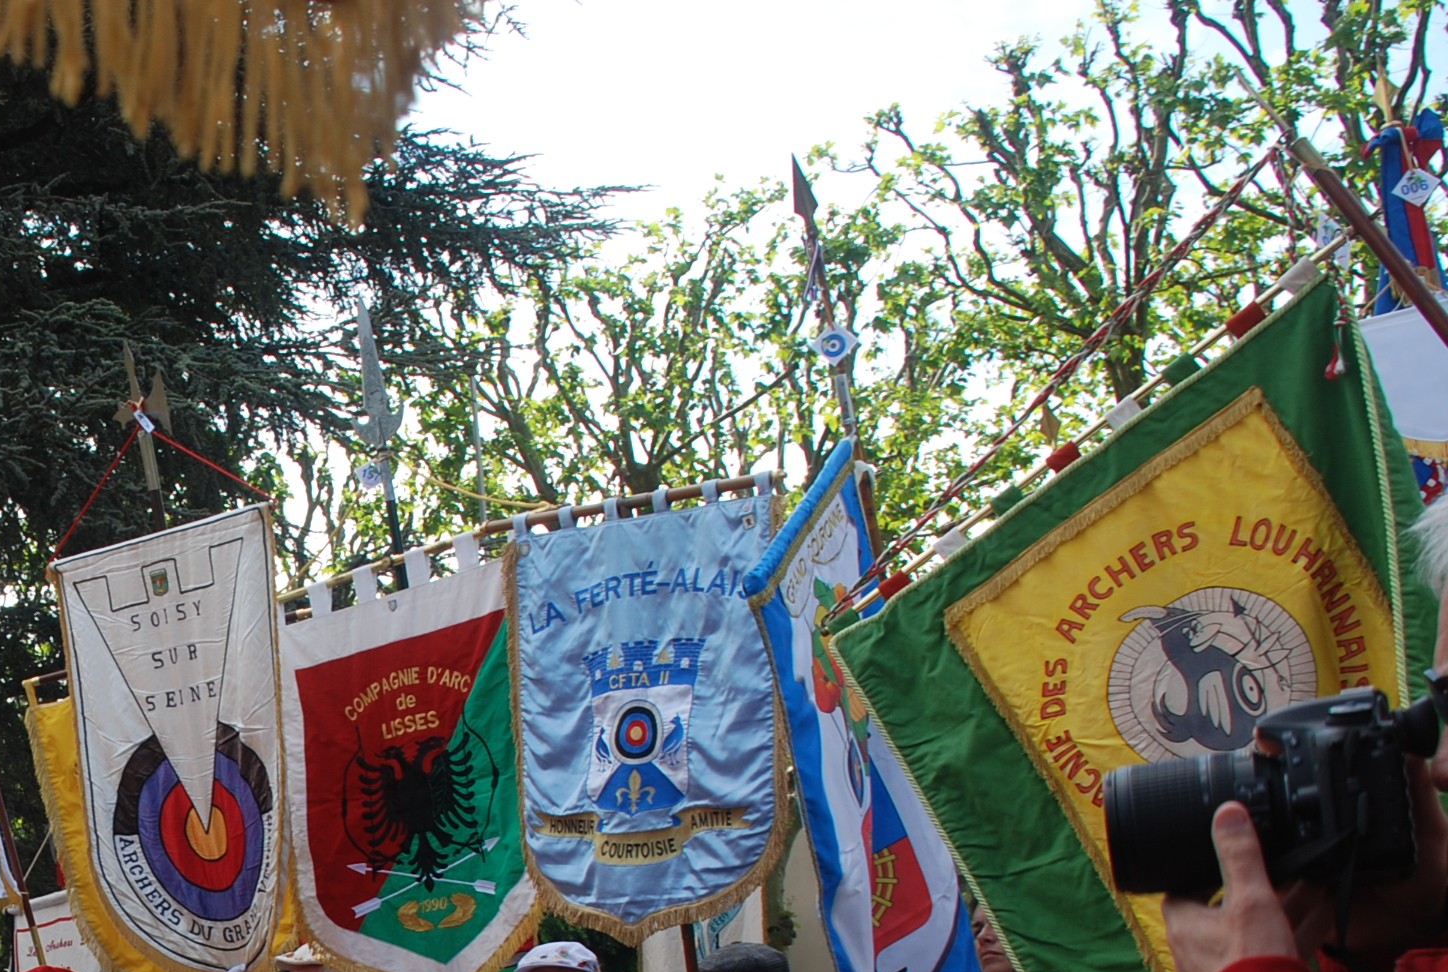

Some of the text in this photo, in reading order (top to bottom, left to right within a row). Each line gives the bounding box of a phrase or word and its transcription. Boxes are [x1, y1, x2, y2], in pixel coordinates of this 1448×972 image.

[130, 600, 201, 632] SOISY
[528, 602, 566, 635] LA
[1040, 658, 1068, 720] DES
[1055, 521, 1199, 645] ARCHERS
[152, 644, 197, 669] SUR
[345, 666, 471, 721] COMPAGNIE D'ARC
[609, 671, 651, 689] CFTA
[145, 681, 217, 712] SEINE
[396, 693, 416, 710] de
[381, 711, 440, 739] LISSES
[549, 818, 595, 835] HONNEUR
[600, 838, 678, 860] COURTOISIE
[120, 837, 184, 926] ARCHERS
[189, 919, 214, 941] DU
[420, 897, 448, 913] 1990
